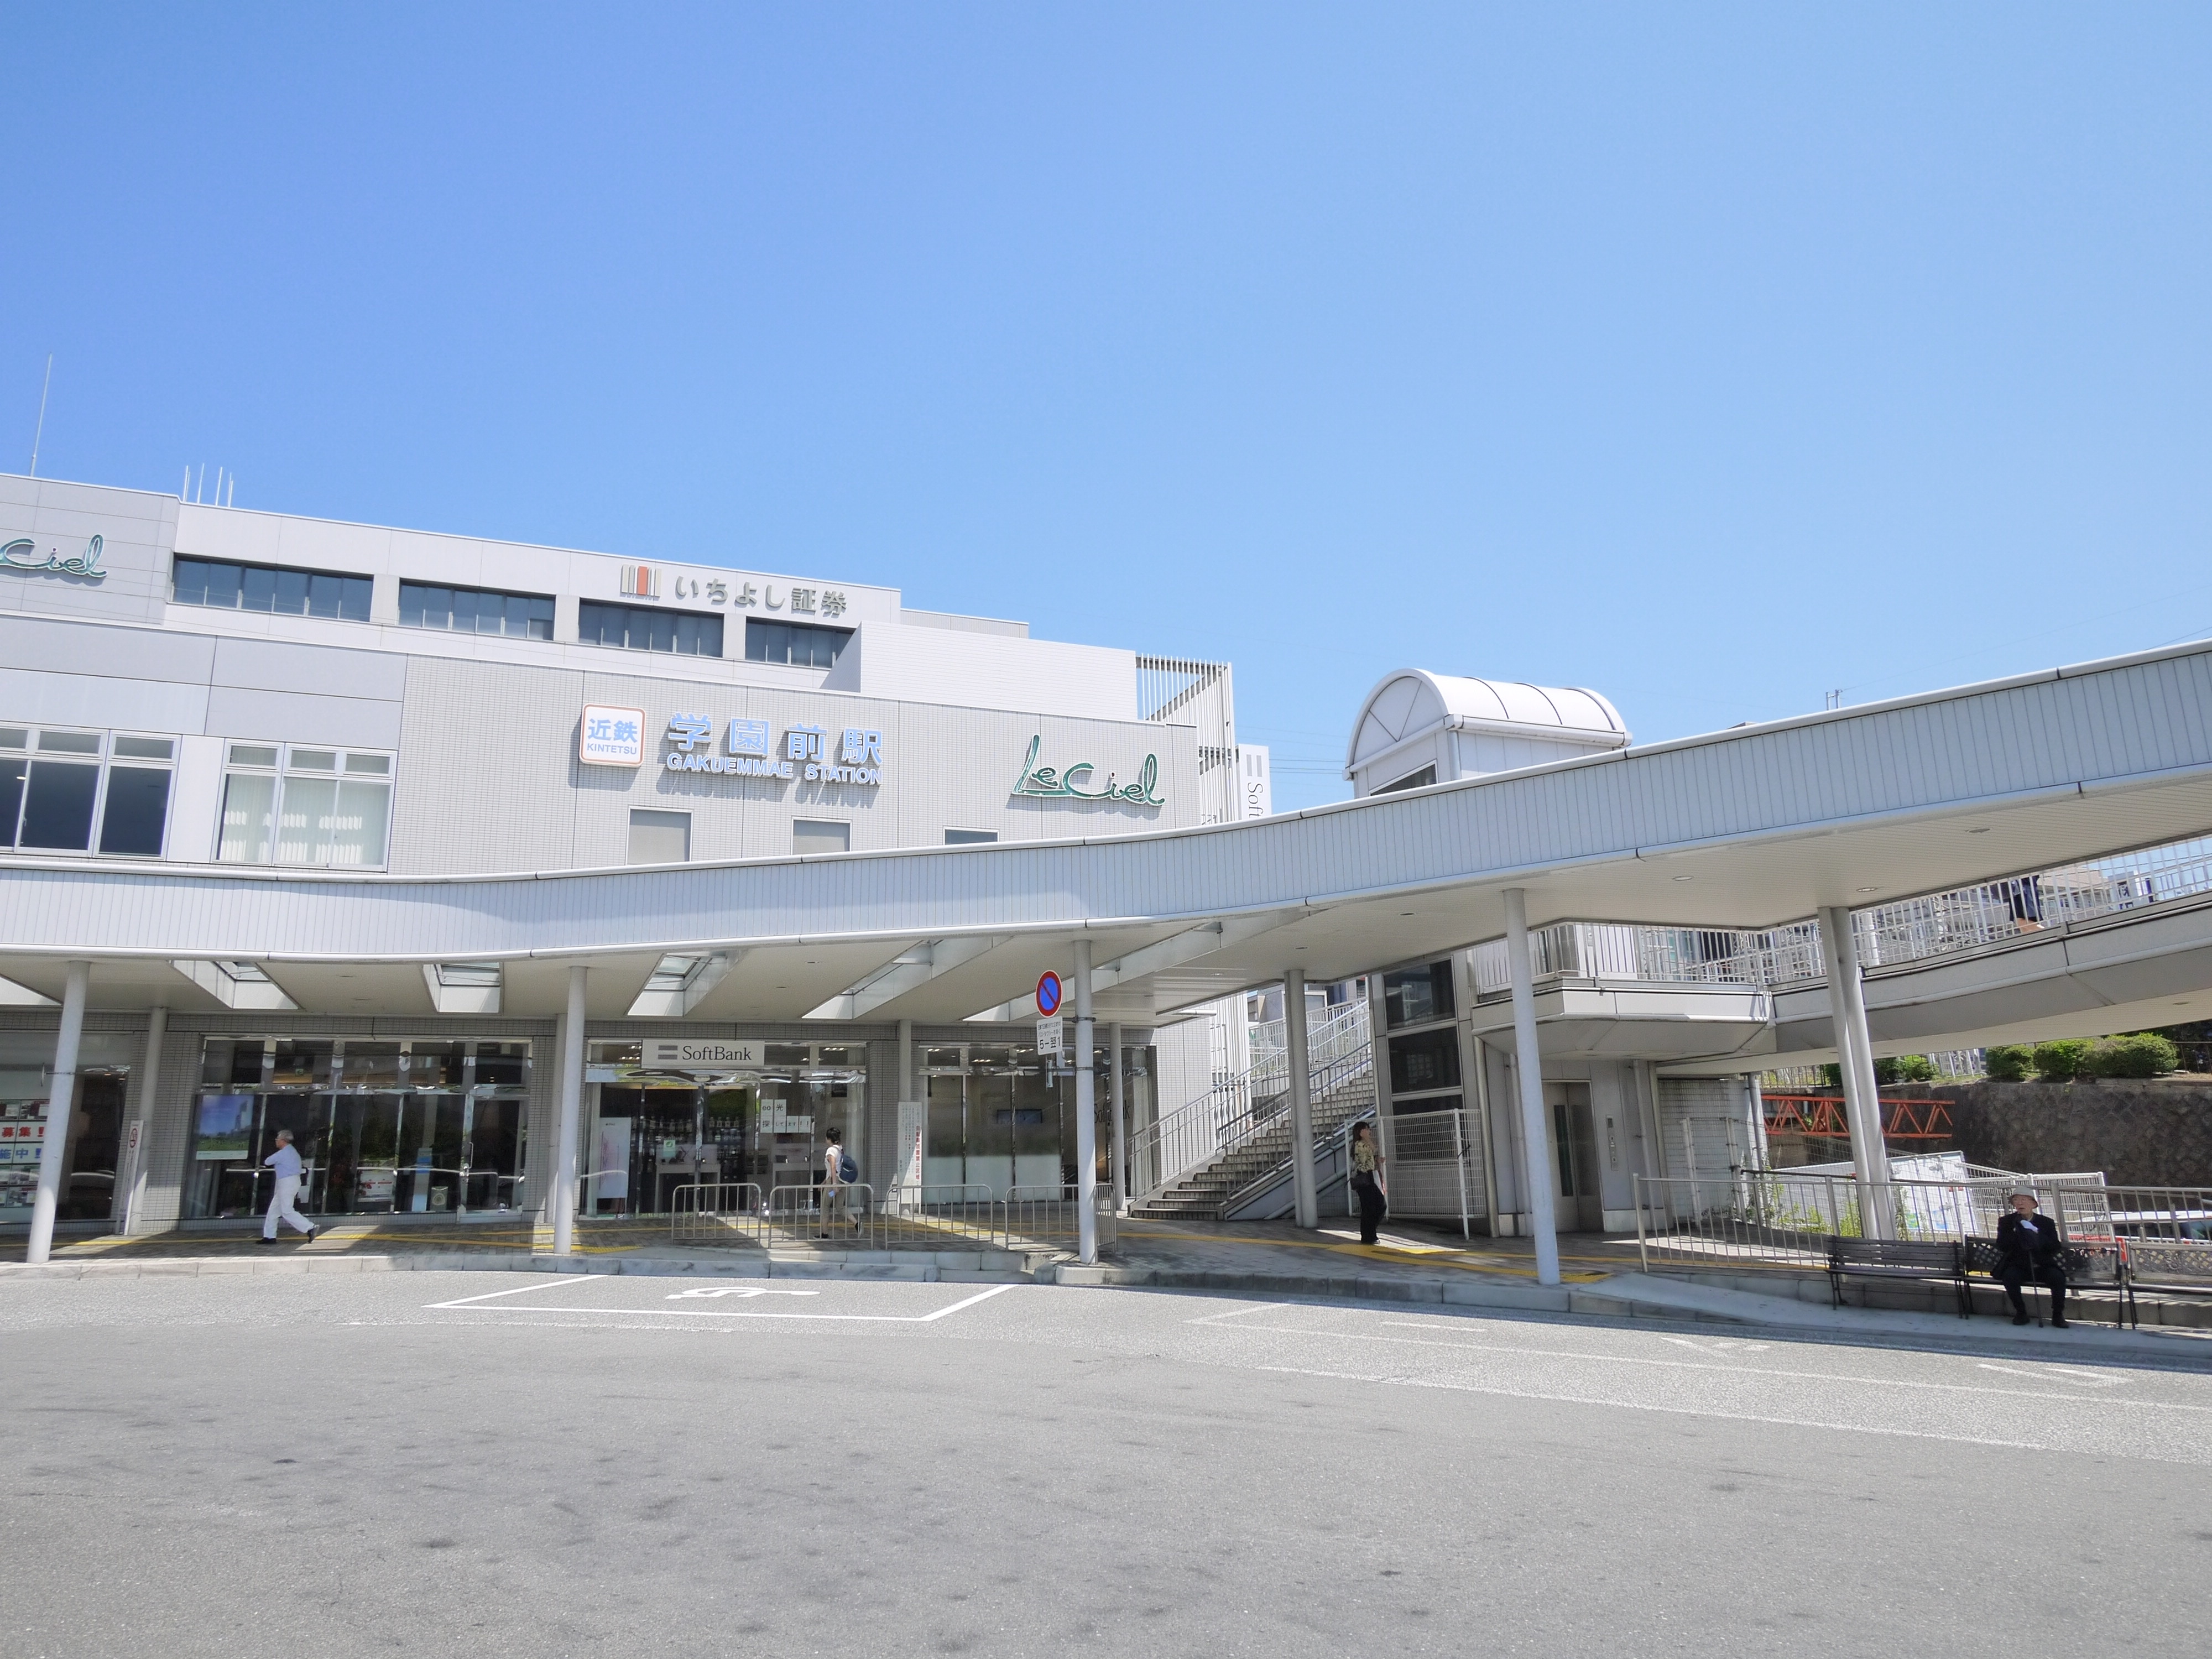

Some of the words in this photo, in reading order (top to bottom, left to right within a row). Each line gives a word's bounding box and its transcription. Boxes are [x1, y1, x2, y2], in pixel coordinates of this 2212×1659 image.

[675, 576, 847, 615] いちよし証券
[587, 718, 638, 743] 近鉄
[667, 712, 883, 766] 学園前駅
[587, 743, 637, 755] KINTETSU
[666, 753, 794, 779] GAKUEMMAE
[805, 763, 883, 786] STATION
[682, 1045, 752, 1061] SoftBank
